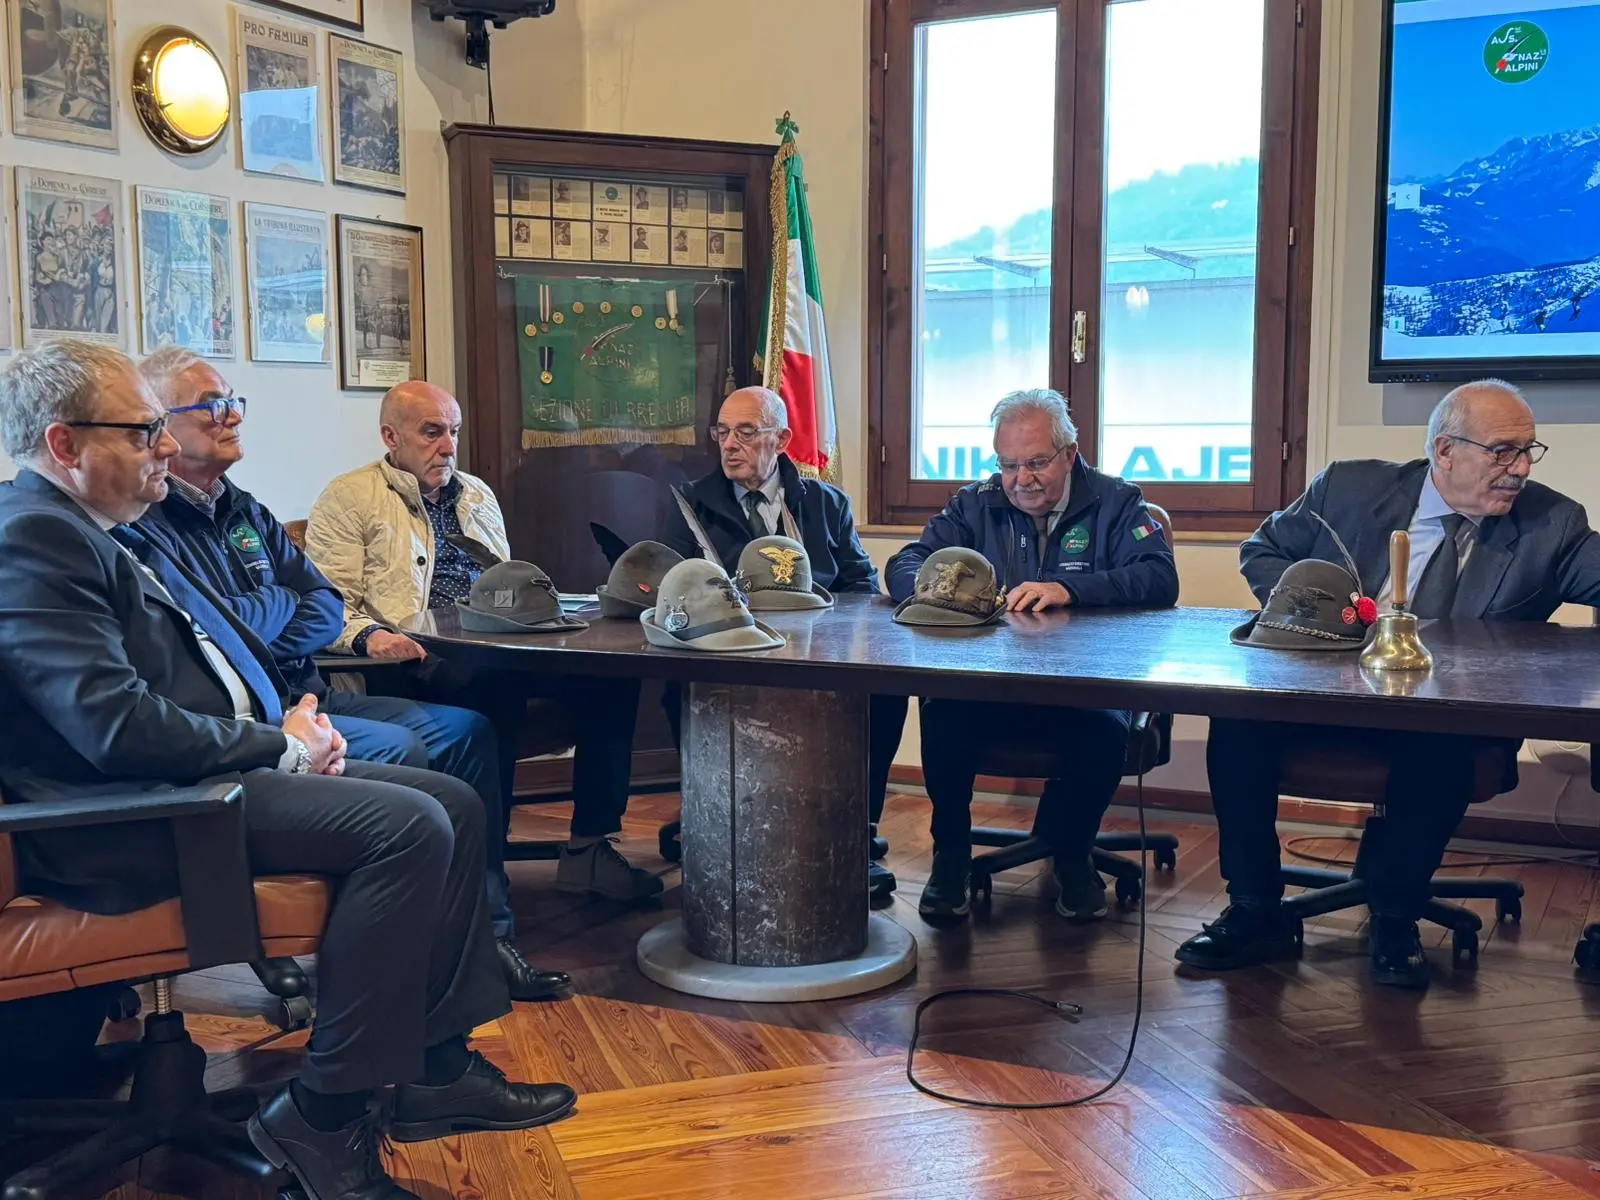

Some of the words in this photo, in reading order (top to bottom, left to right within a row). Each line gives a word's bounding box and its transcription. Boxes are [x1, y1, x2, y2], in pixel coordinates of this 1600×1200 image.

[243, 20, 266, 36] PRO
[268, 26, 309, 47] FAMILIA
[1504, 62, 1538, 72] ALPINI
